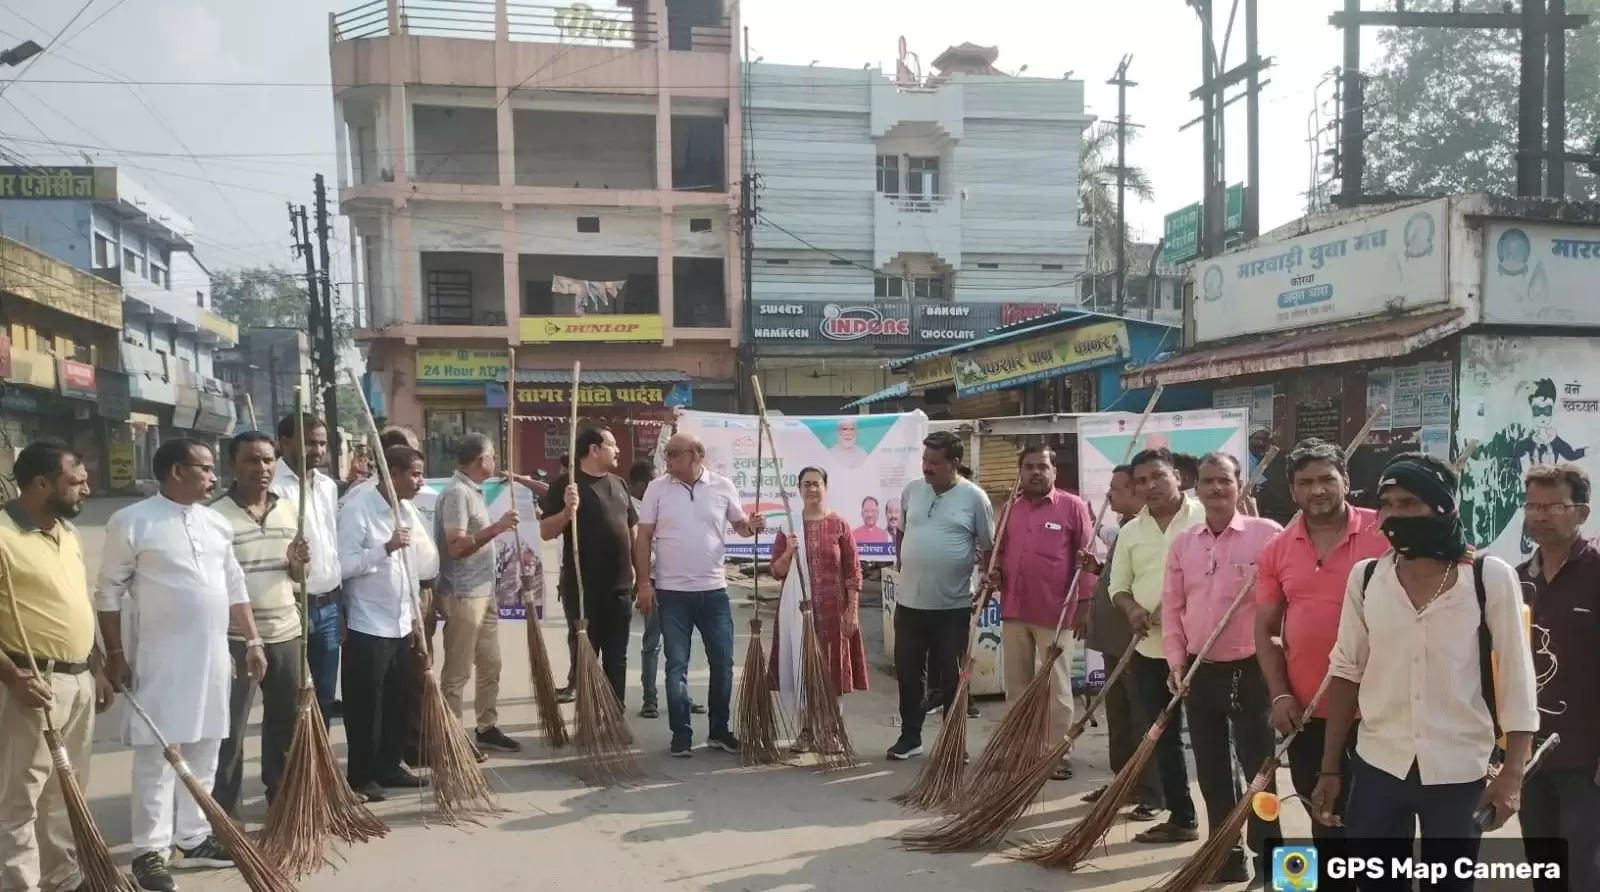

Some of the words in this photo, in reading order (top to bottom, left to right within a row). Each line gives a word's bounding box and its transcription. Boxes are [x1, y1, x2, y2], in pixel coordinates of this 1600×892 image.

[760, 304, 804, 314] SWEETS
[926, 307, 969, 316] BAKERY
[565, 324, 640, 333] DUNLOP
[829, 317, 909, 335] INDORE
[754, 328, 809, 338] NAMKEEN
[921, 329, 976, 339] CHOCOLATE
[424, 365, 440, 377] 24
[444, 364, 474, 377] Hour
[516, 387, 563, 403] सागर
